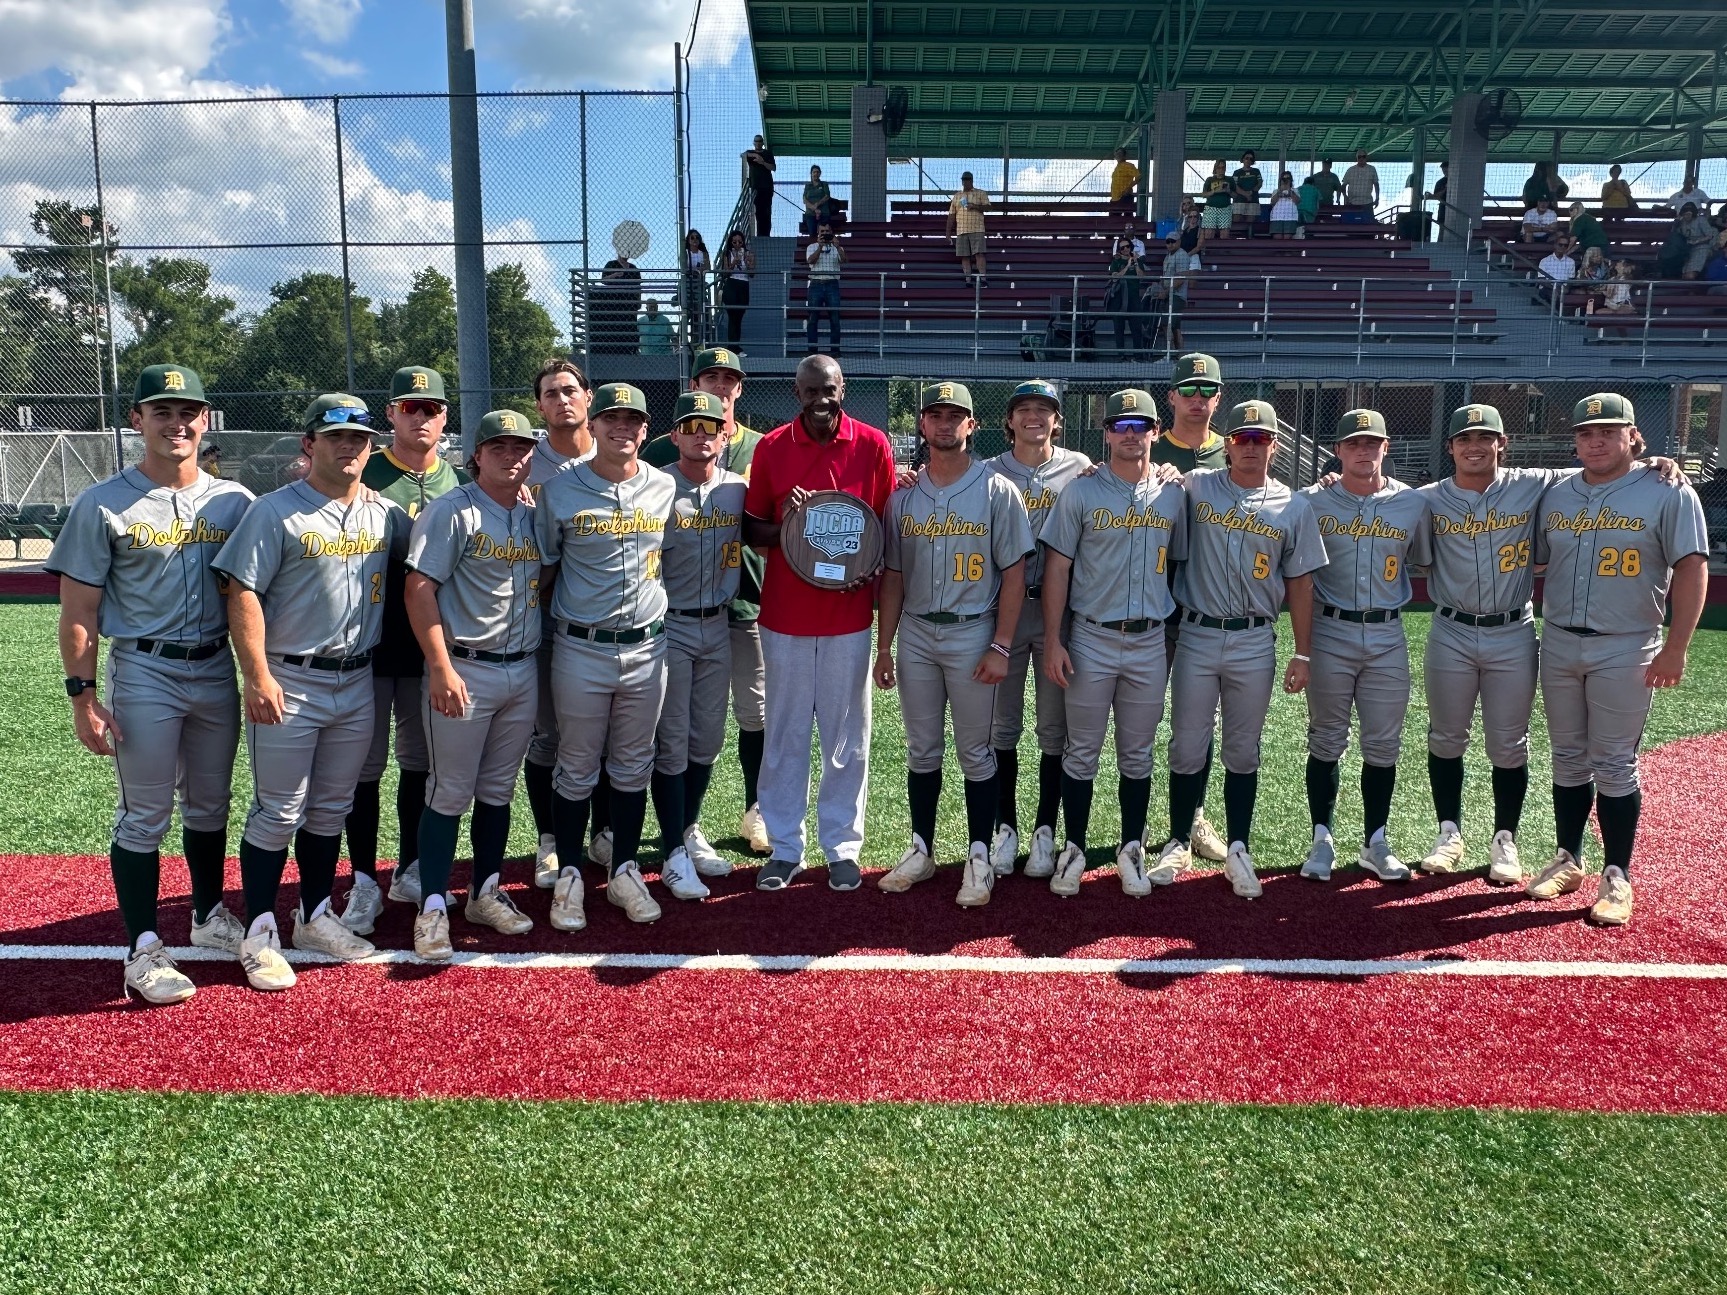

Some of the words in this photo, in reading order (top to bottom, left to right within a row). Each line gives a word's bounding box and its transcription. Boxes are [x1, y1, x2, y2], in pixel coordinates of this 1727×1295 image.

[126, 517, 231, 551] Dolphin
[674, 506, 739, 535] olphin
[806, 510, 864, 537] NJCAA
[901, 512, 988, 543] Dolphins
[1196, 501, 1283, 540] Dolphins
[1318, 515, 1408, 542] Dolphins
[1432, 508, 1529, 540] Dolphins
[1545, 506, 1646, 537] Dolphins
[300, 528, 386, 564] Dolphin
[471, 533, 540, 568] Dolphi
[720, 540, 742, 570] 13
[845, 540, 859, 550] 23
[952, 552, 985, 582] 16
[1252, 551, 1271, 580] 5
[1383, 554, 1399, 582] 8
[1597, 546, 1642, 577] 28
